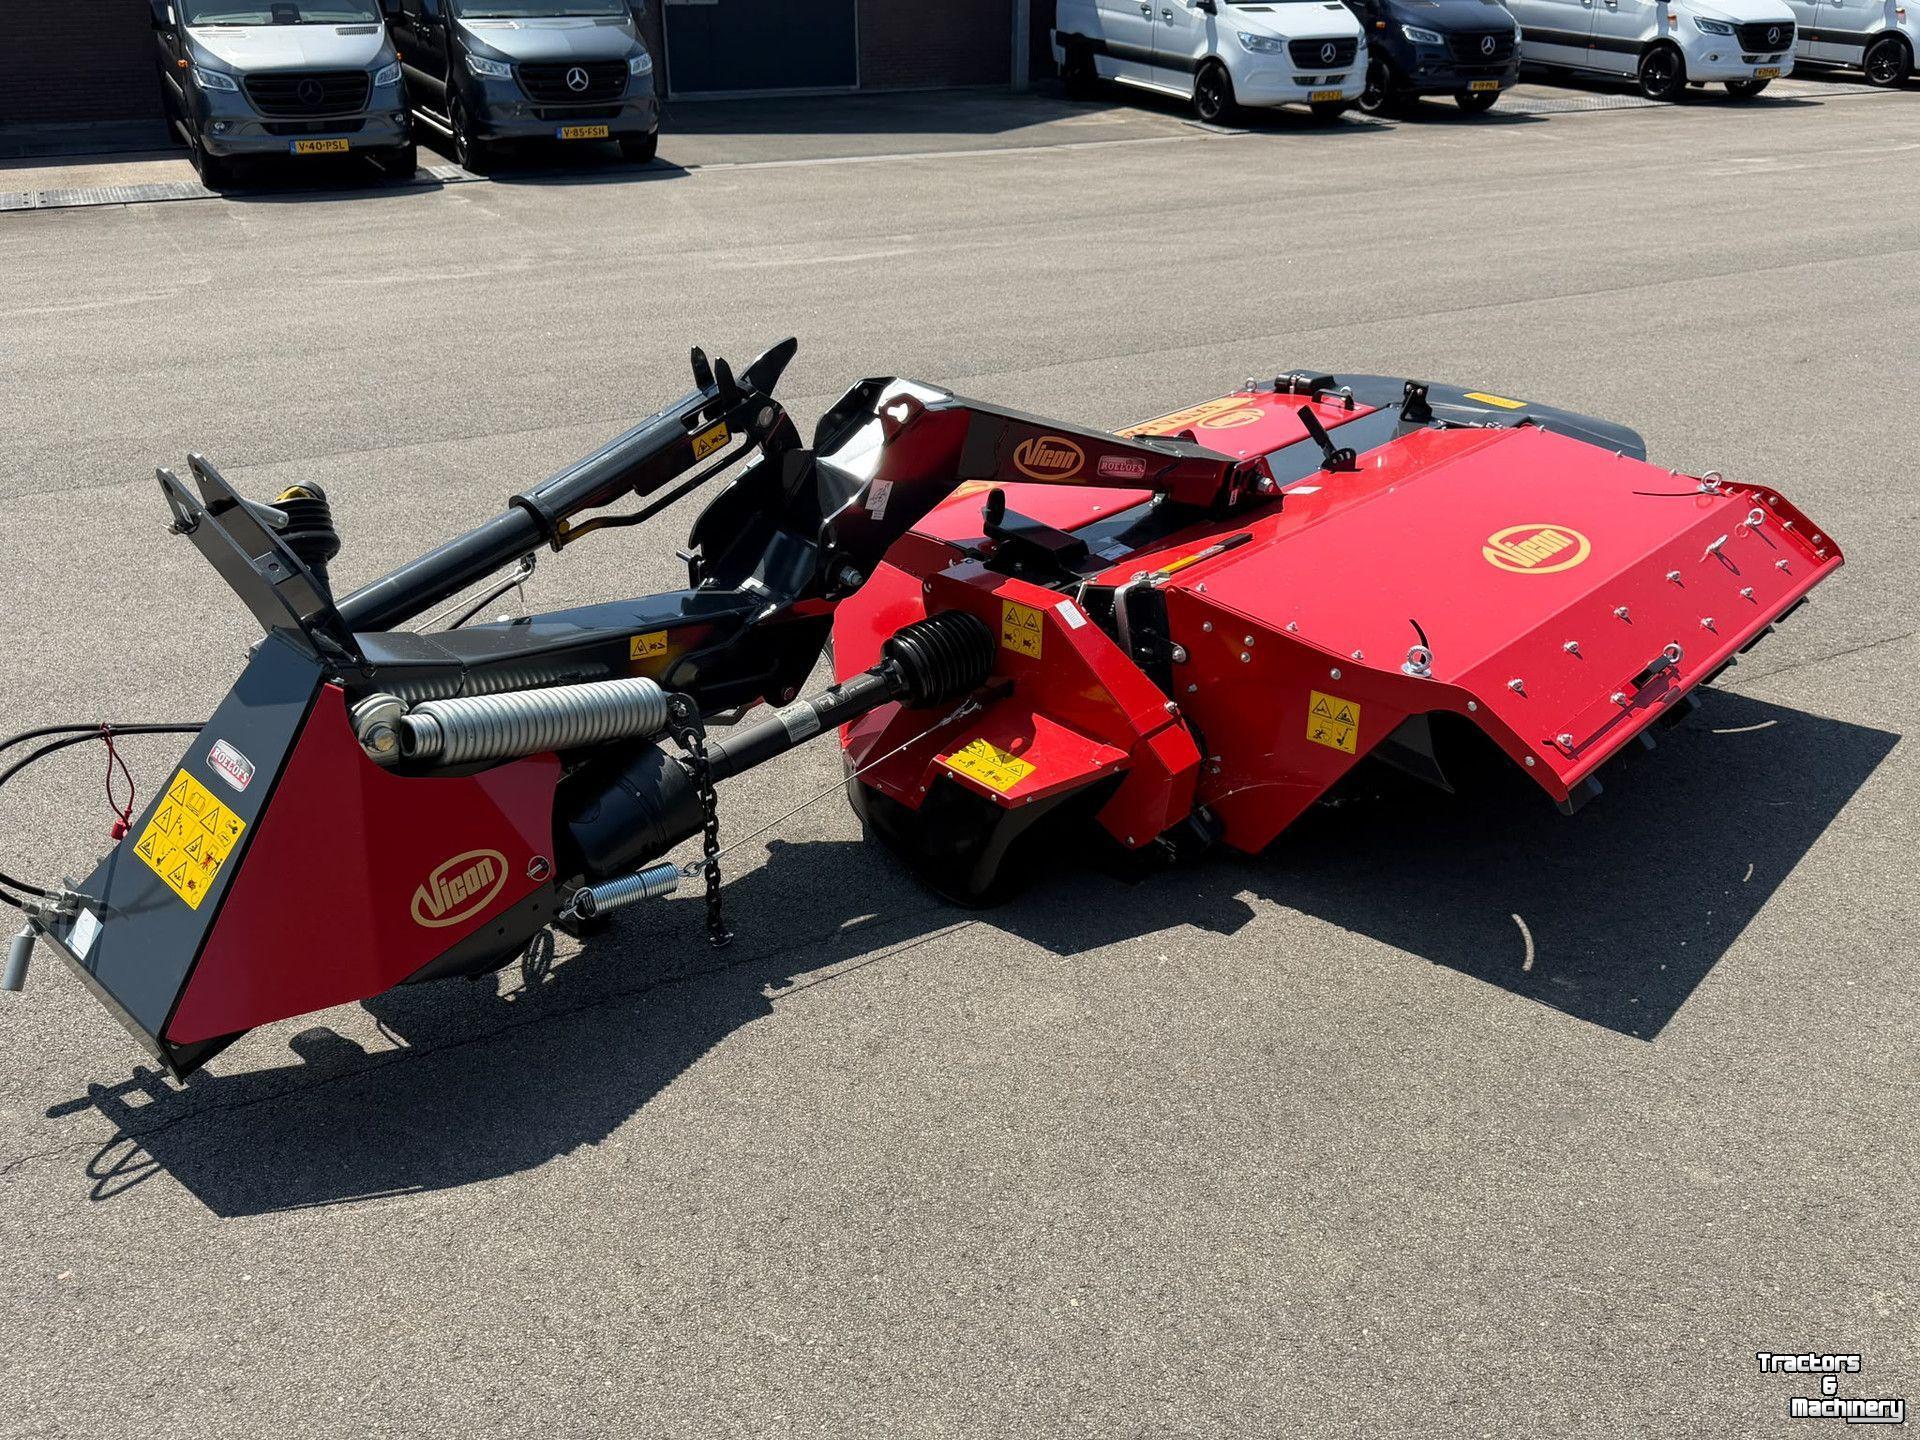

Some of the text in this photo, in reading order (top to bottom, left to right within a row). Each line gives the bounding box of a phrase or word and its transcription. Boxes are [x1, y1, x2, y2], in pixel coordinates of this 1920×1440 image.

[1021, 437, 1078, 470] Vicon
[1483, 527, 1574, 569] Vicon
[212, 747, 250, 783] ROELOFS
[419, 857, 496, 918] Vicon
